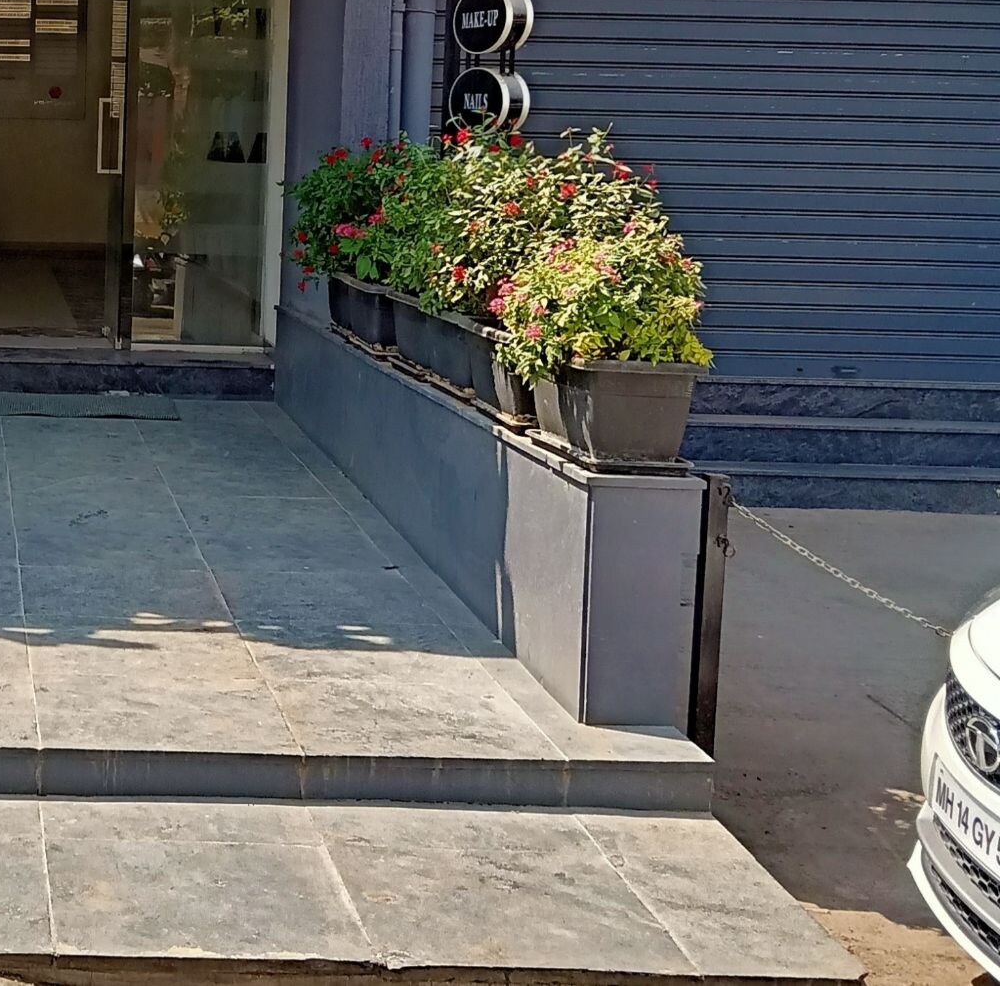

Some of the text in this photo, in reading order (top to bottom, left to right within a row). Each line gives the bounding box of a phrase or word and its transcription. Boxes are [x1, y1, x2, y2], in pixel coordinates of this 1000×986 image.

[461, 9, 499, 29] MAKE-UP
[463, 93, 489, 110] NAILS
[935, 776, 955, 819] MH
[957, 800, 969, 835] 14
[972, 816, 996, 855] GY
